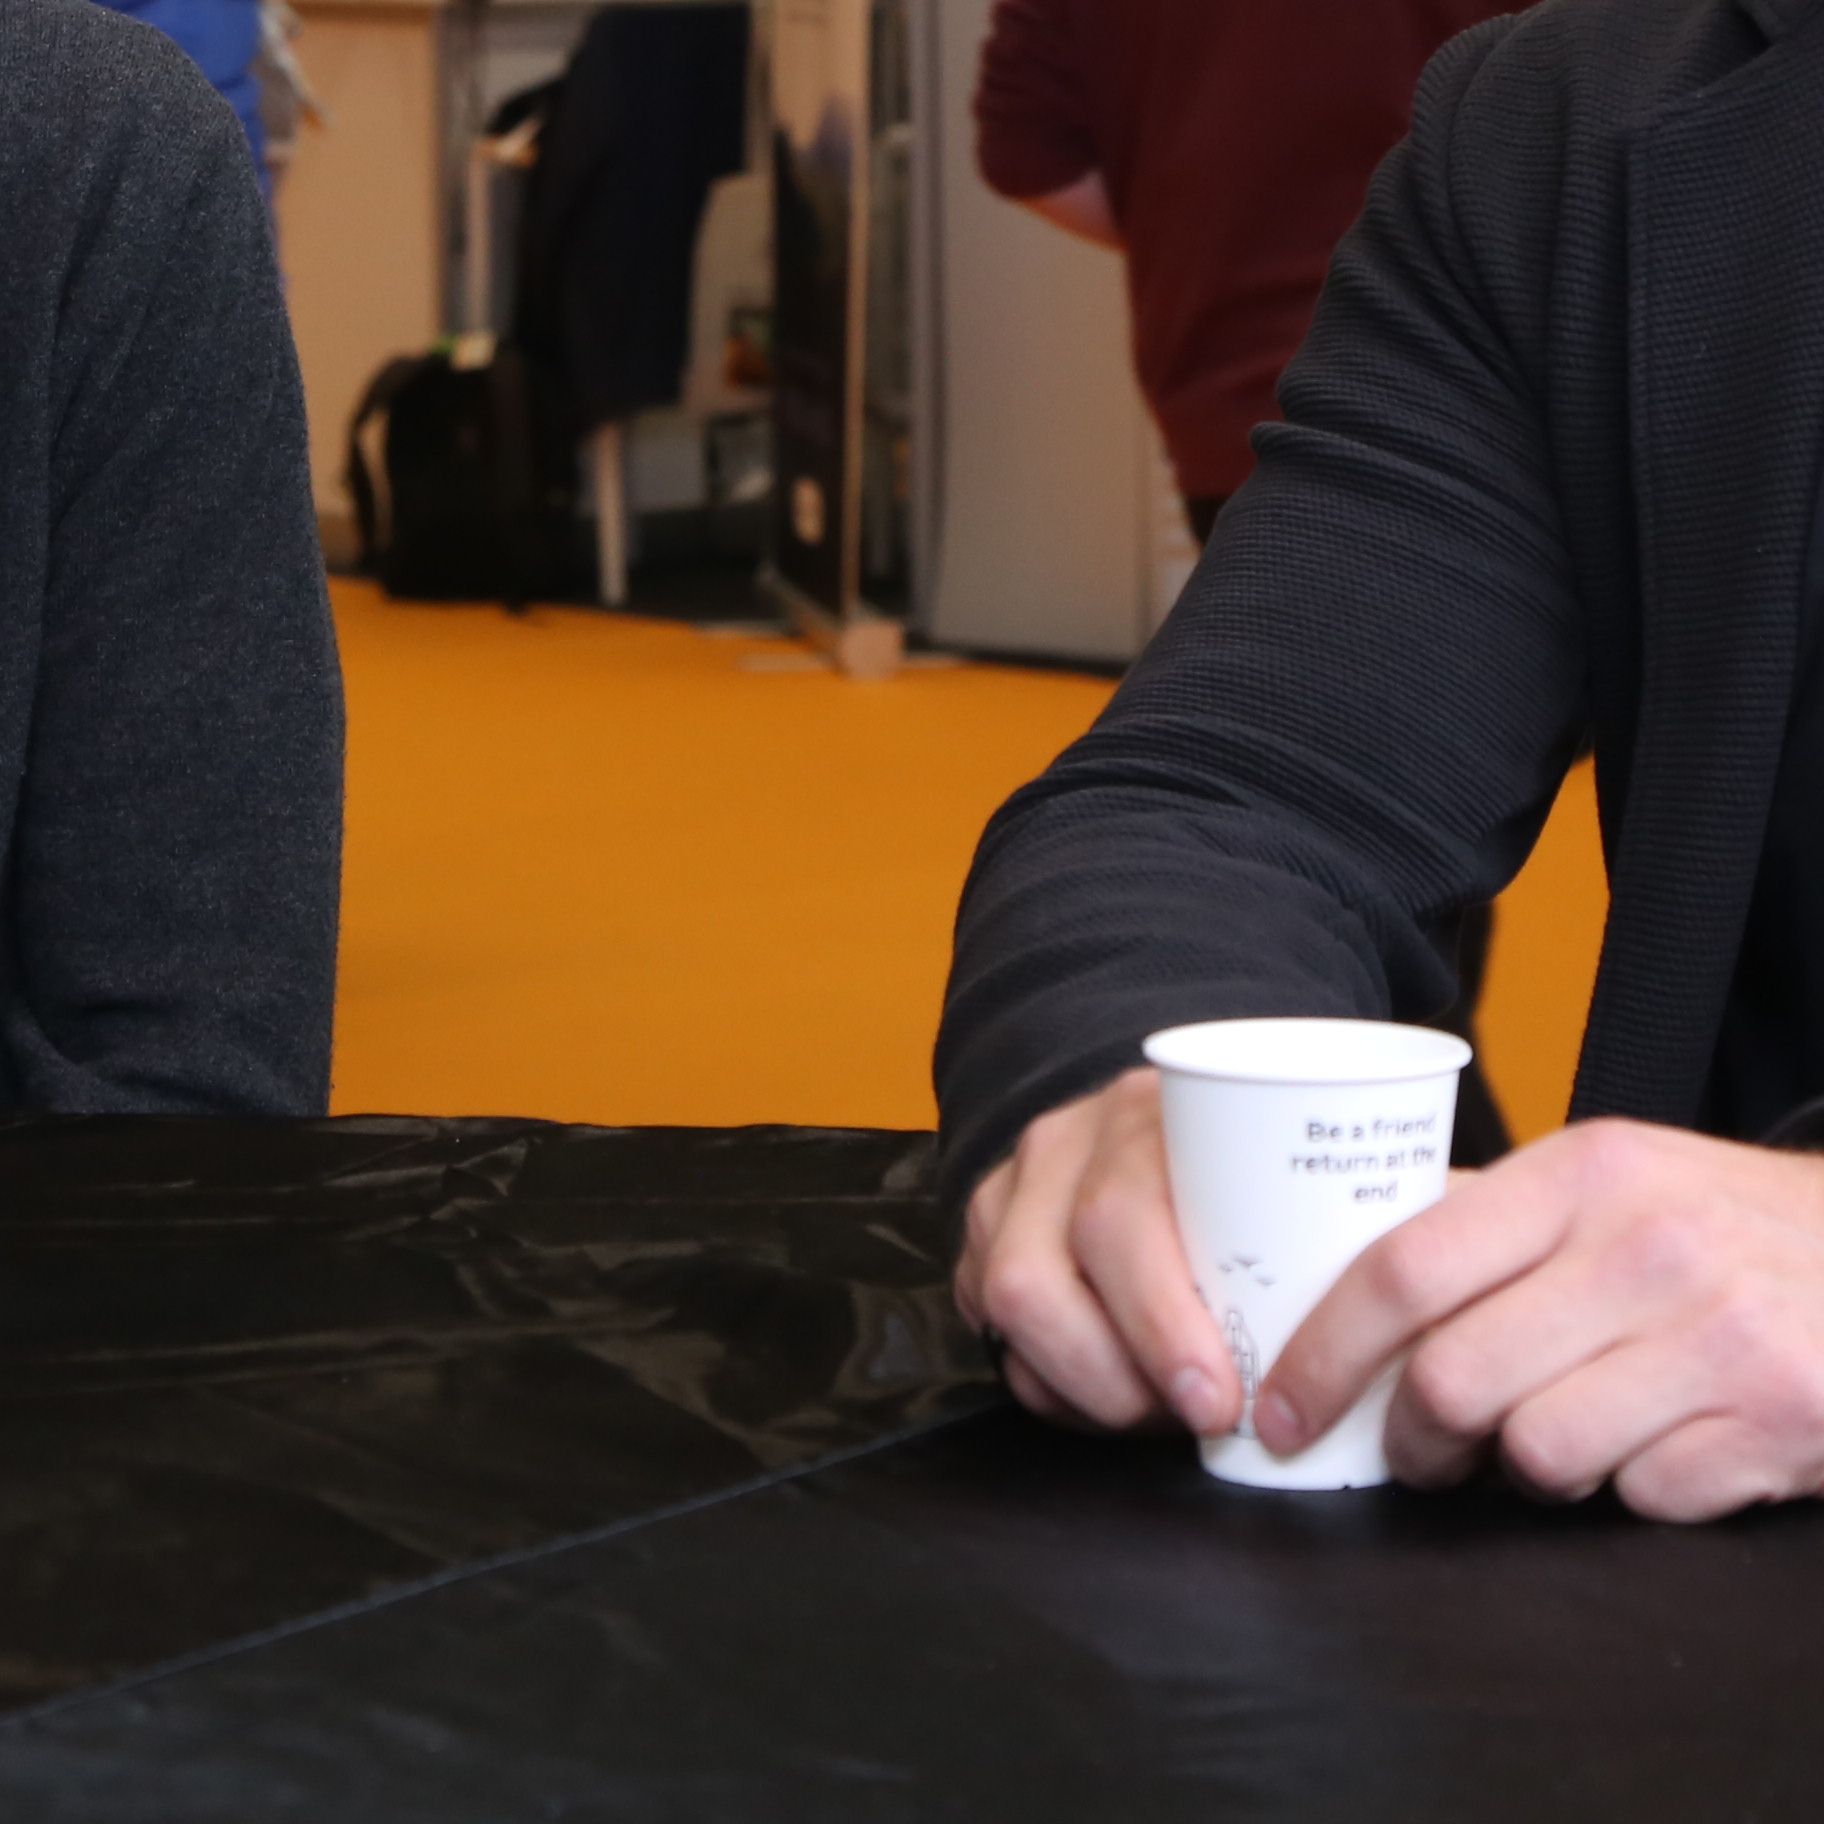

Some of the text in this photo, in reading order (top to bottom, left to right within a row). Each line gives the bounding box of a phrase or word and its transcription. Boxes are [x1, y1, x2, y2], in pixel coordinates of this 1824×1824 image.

[1307, 1114, 1437, 1142] Be a friend
[1291, 1143, 1437, 1173] return at the
[1354, 1178, 1399, 1202] end
